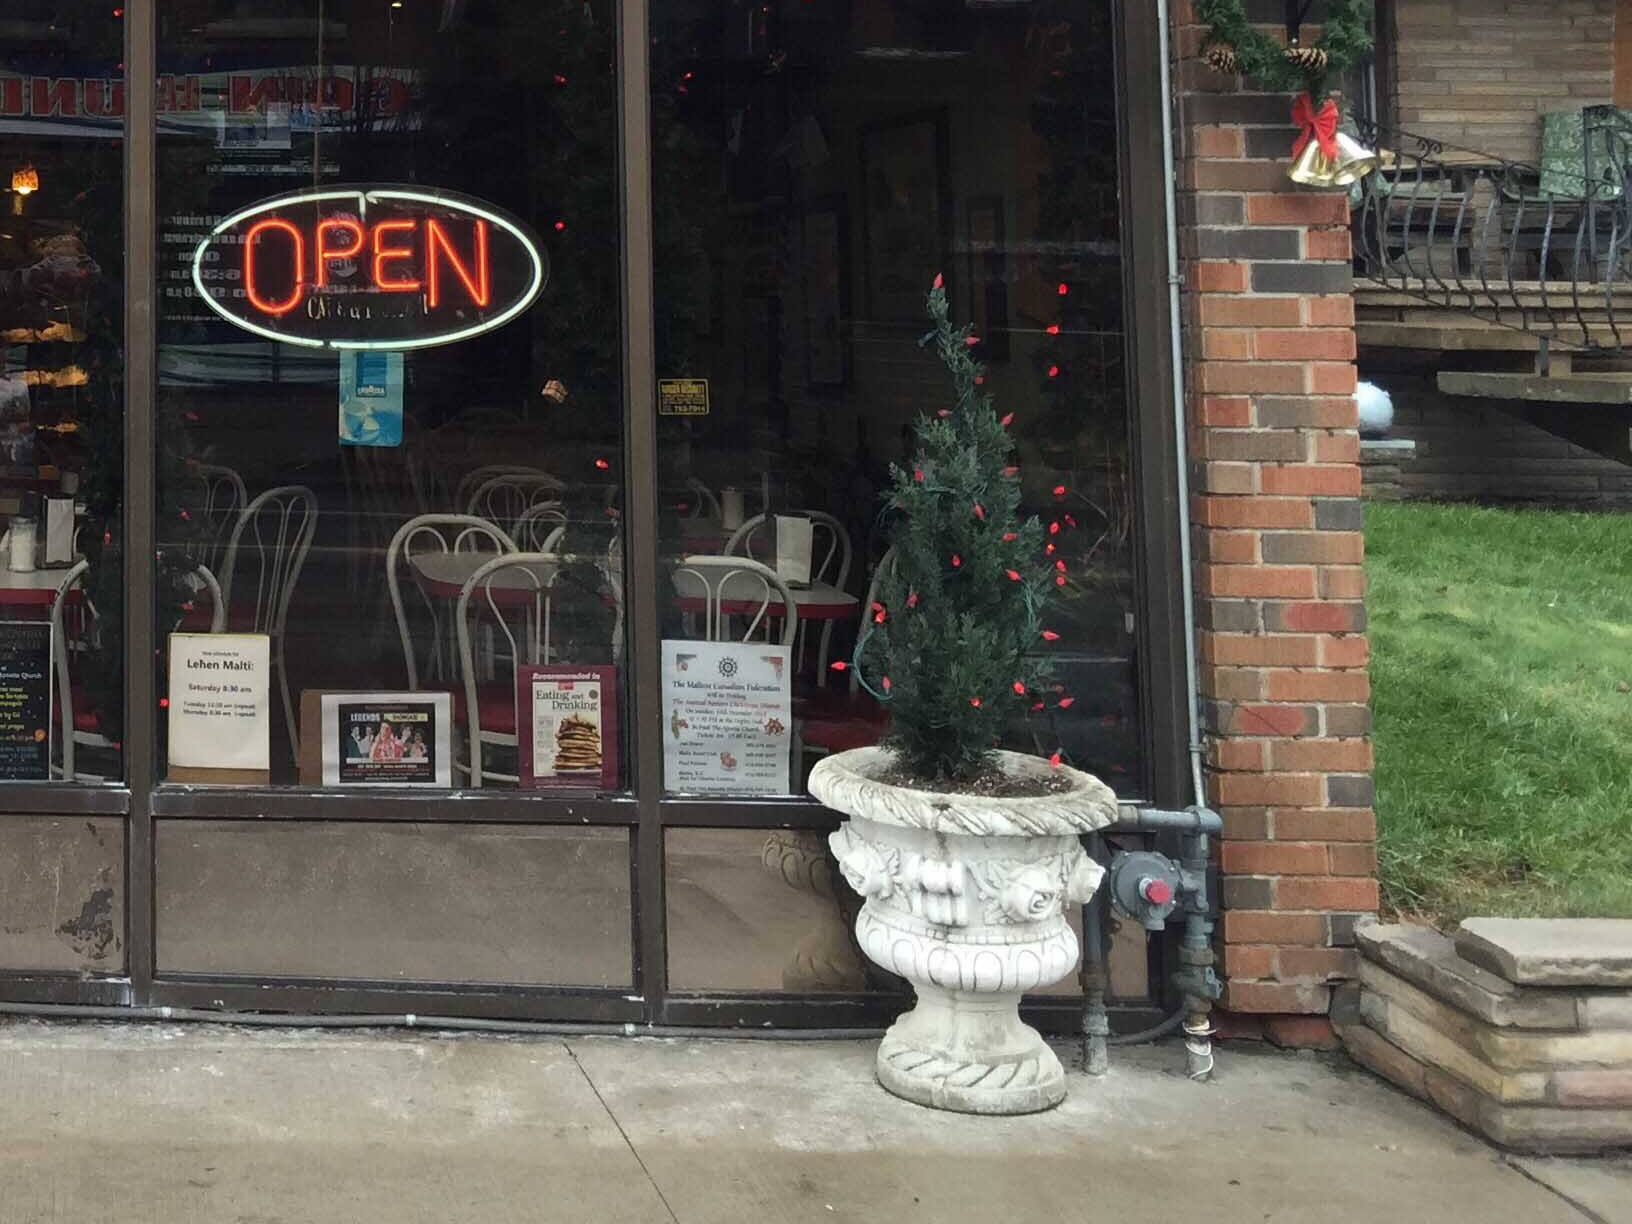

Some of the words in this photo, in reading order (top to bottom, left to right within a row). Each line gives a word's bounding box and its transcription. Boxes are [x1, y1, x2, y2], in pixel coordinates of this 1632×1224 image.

[244, 218, 490, 314] OPEN
[536, 690, 570, 702] Eating
[552, 701, 598, 712] Drinking
